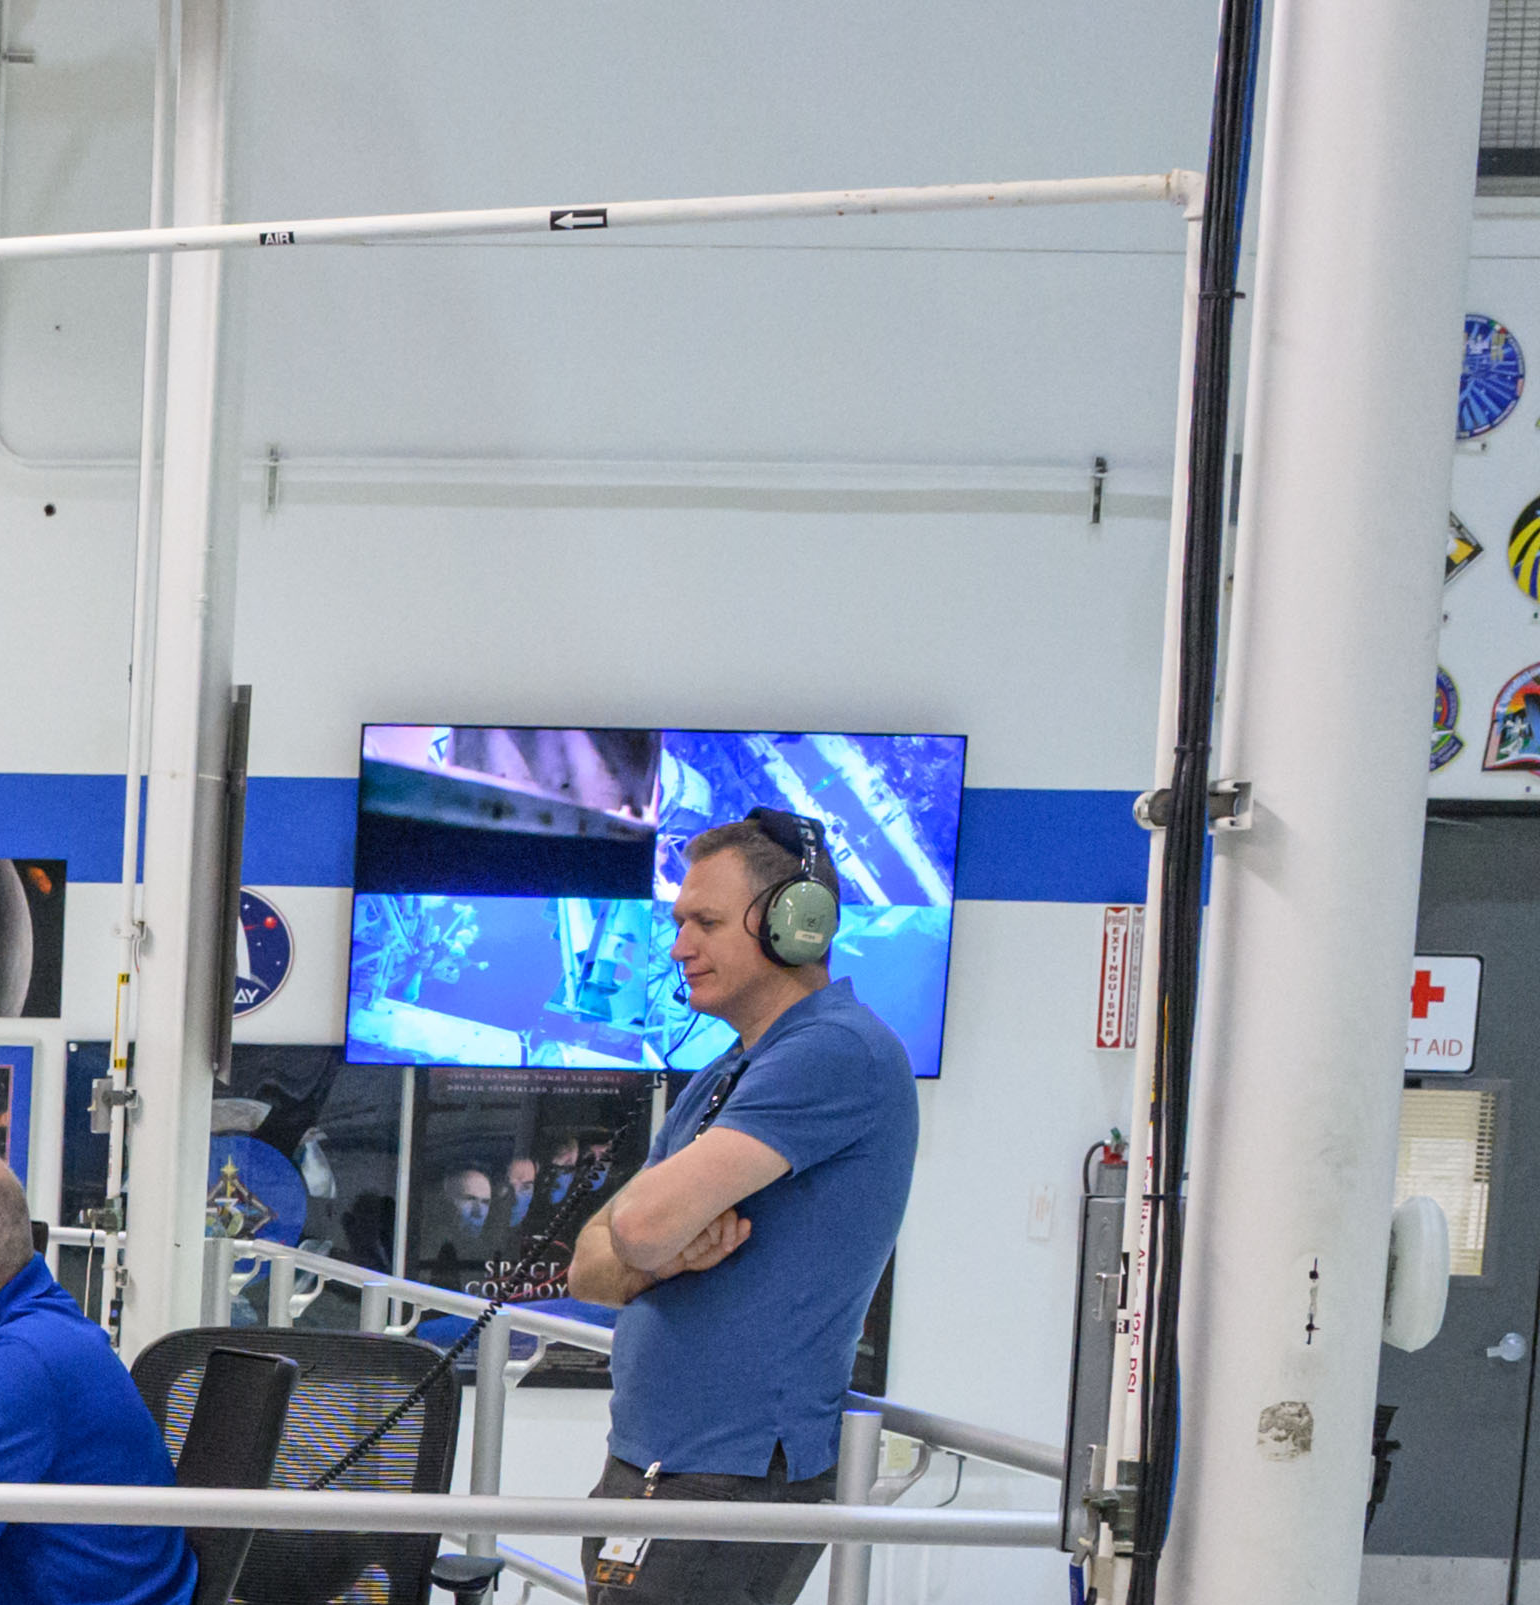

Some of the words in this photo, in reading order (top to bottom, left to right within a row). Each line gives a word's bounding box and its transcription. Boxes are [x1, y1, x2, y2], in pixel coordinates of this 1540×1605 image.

[265, 232, 291, 245] AIR
[1105, 926, 1120, 1038] EXTINGUISHER
[1426, 1038, 1463, 1057] AID
[465, 1280, 569, 1299] COWBOY
